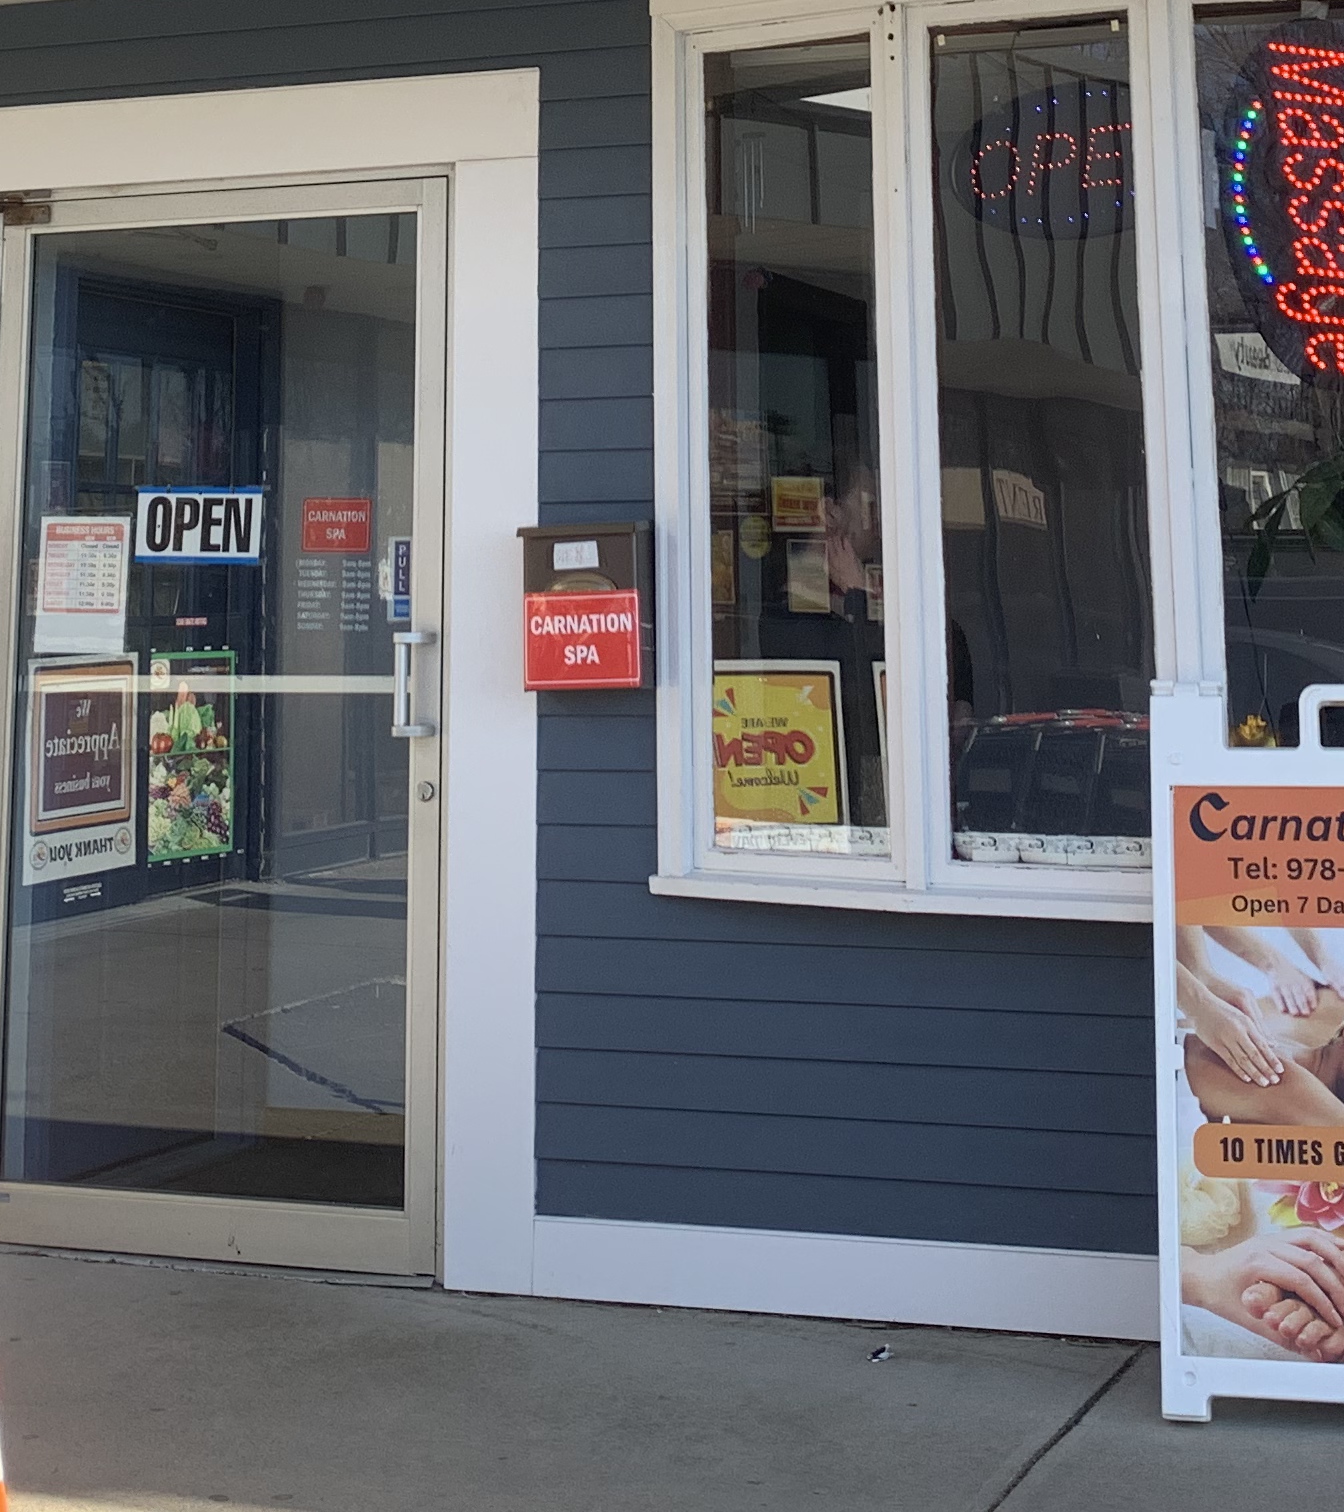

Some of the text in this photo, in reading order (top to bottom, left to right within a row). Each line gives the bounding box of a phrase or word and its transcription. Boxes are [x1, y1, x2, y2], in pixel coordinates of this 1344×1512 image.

[969, 121, 1133, 200] OPE
[145, 496, 254, 553] OPEN
[307, 510, 367, 523] CARNATION
[325, 528, 347, 540] SPA
[398, 544, 408, 592] PULL
[530, 612, 632, 636] CARNATION
[564, 644, 600, 665] SPA
[1227, 857, 1278, 881] Tel:
[1231, 894, 1290, 917] Open
[1297, 896, 1309, 914] 7
[1219, 1136, 1244, 1163] 10
[1254, 1138, 1324, 1166] TIMES
